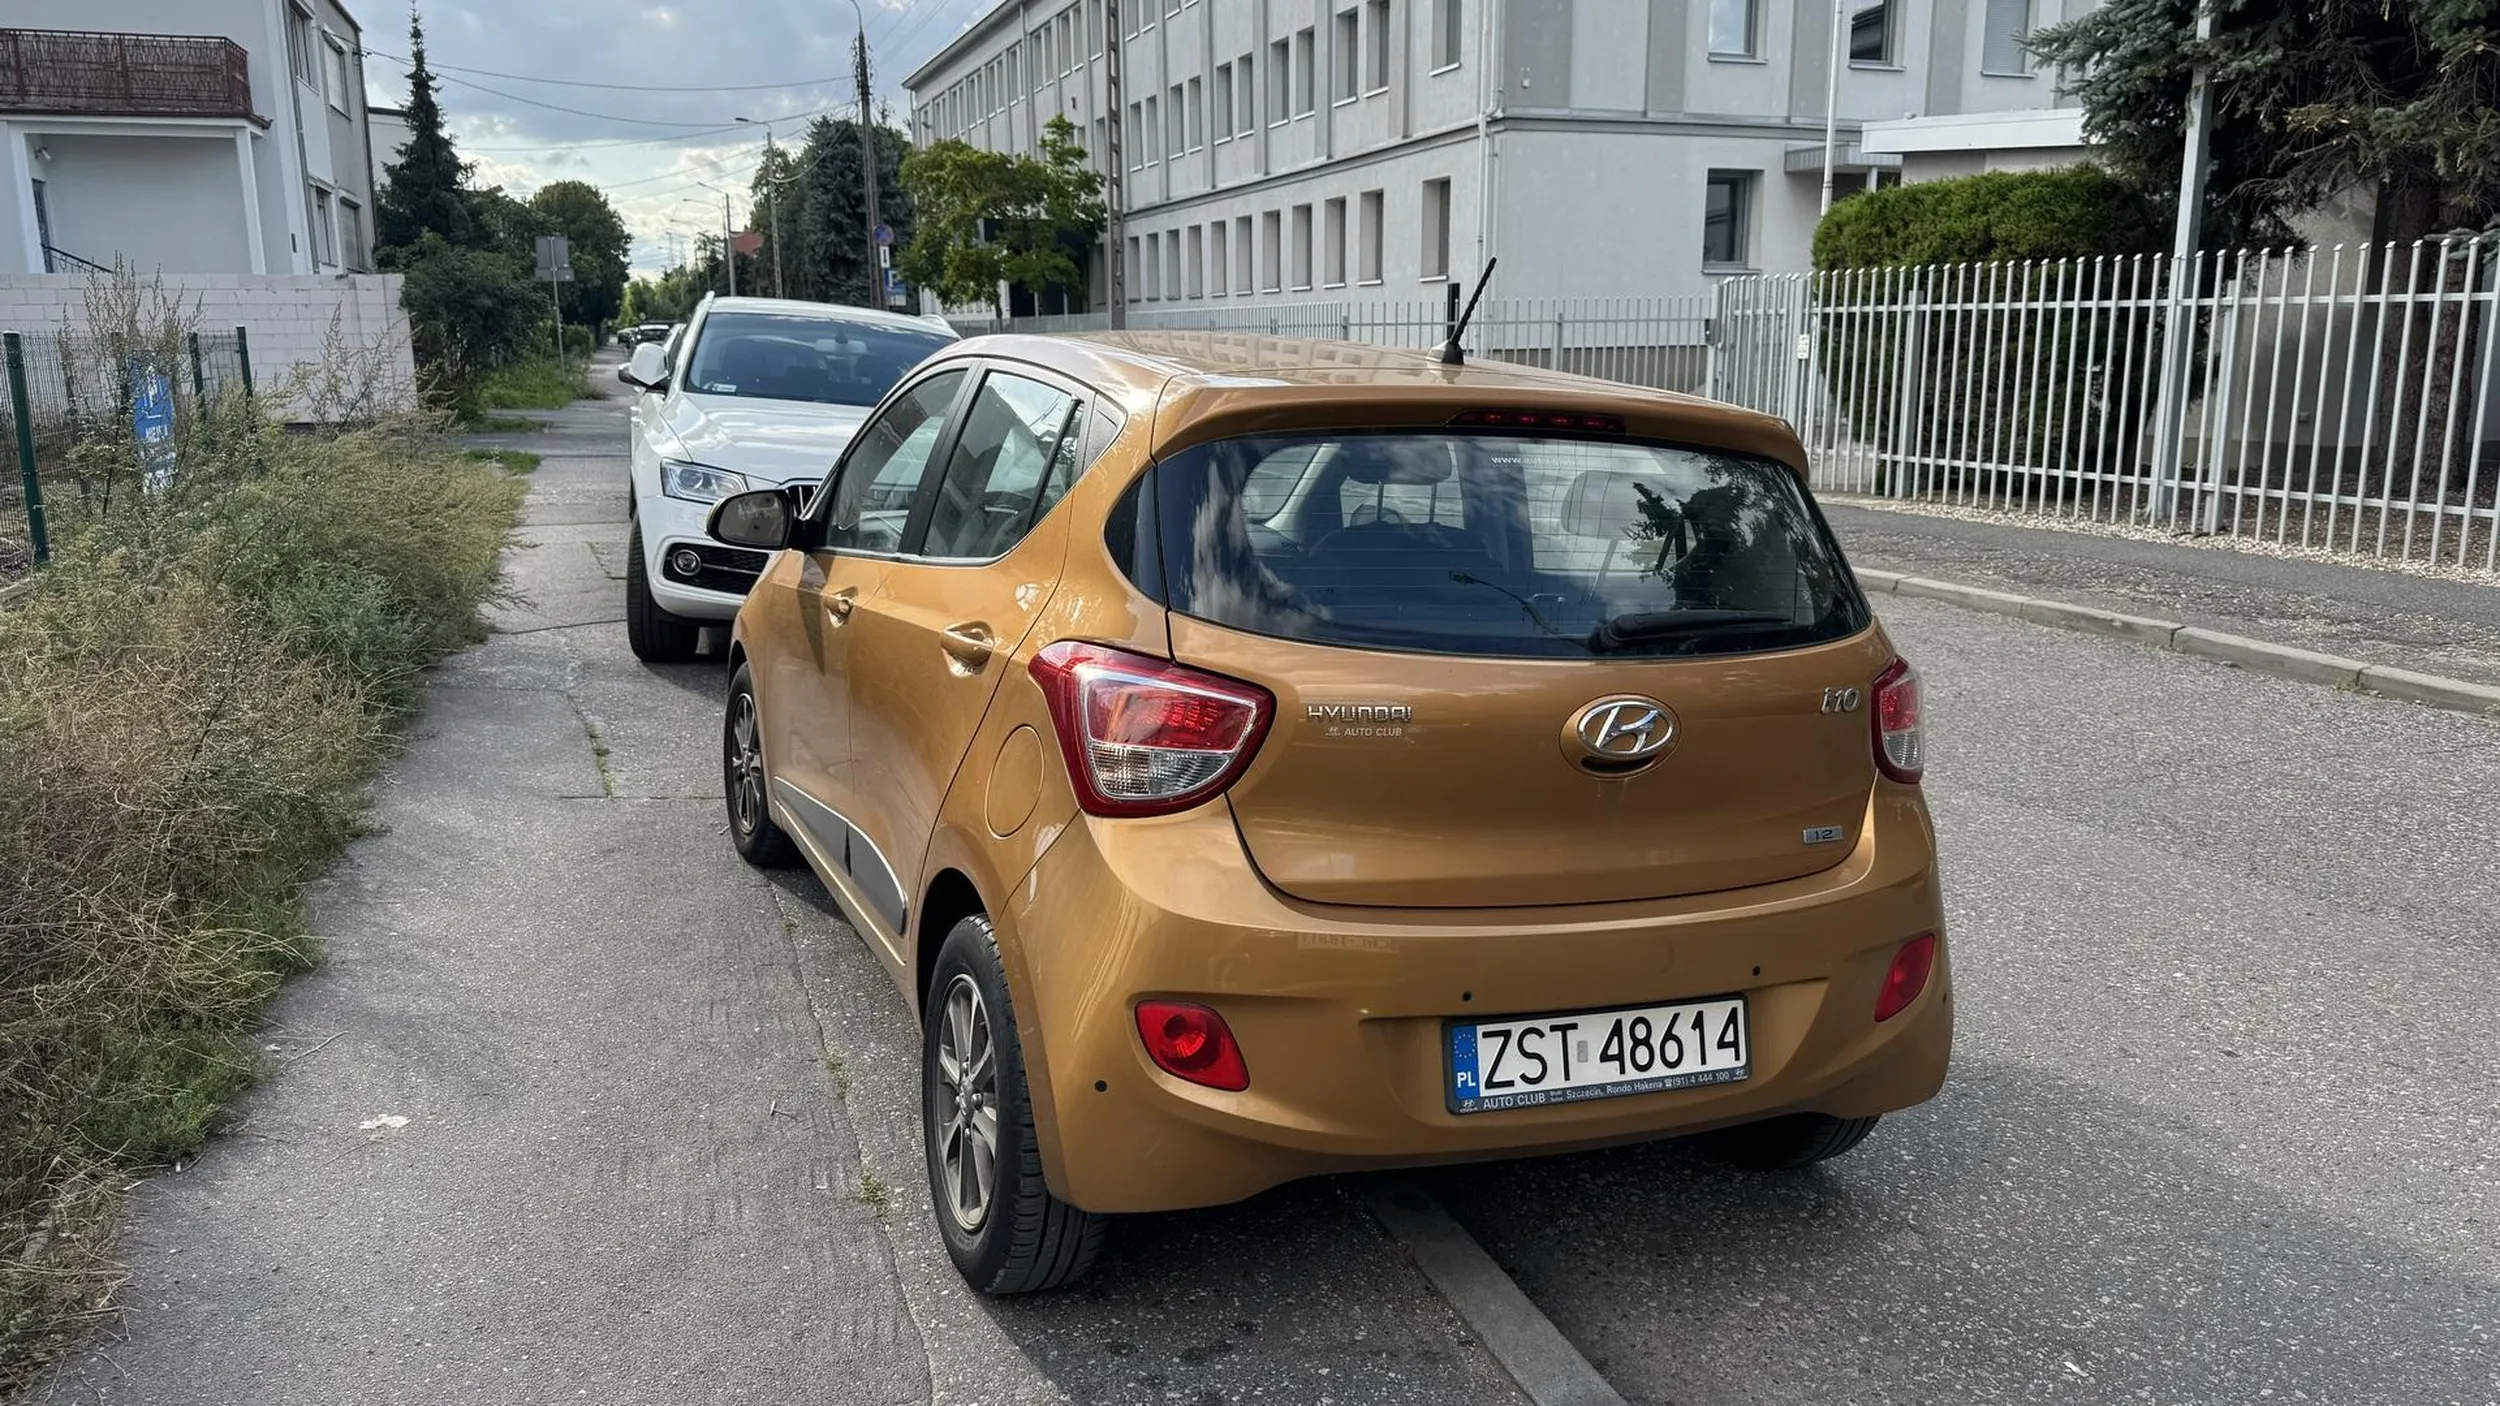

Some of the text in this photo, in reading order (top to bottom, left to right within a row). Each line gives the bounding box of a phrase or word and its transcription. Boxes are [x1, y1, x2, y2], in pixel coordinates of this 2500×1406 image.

[1821, 687, 1860, 713] i10
[1308, 705, 1411, 721] HYUNDAI
[1343, 727, 1372, 737] AUTO
[1375, 727, 1402, 737] CLUB
[1481, 1006, 1741, 1090] ZST 48614
[1457, 1071, 1476, 1088] PL
[1483, 1096, 1514, 1110] AUTO
[1517, 1092, 1546, 1106] CLUB
[1606, 1083, 1633, 1095] Rondo
